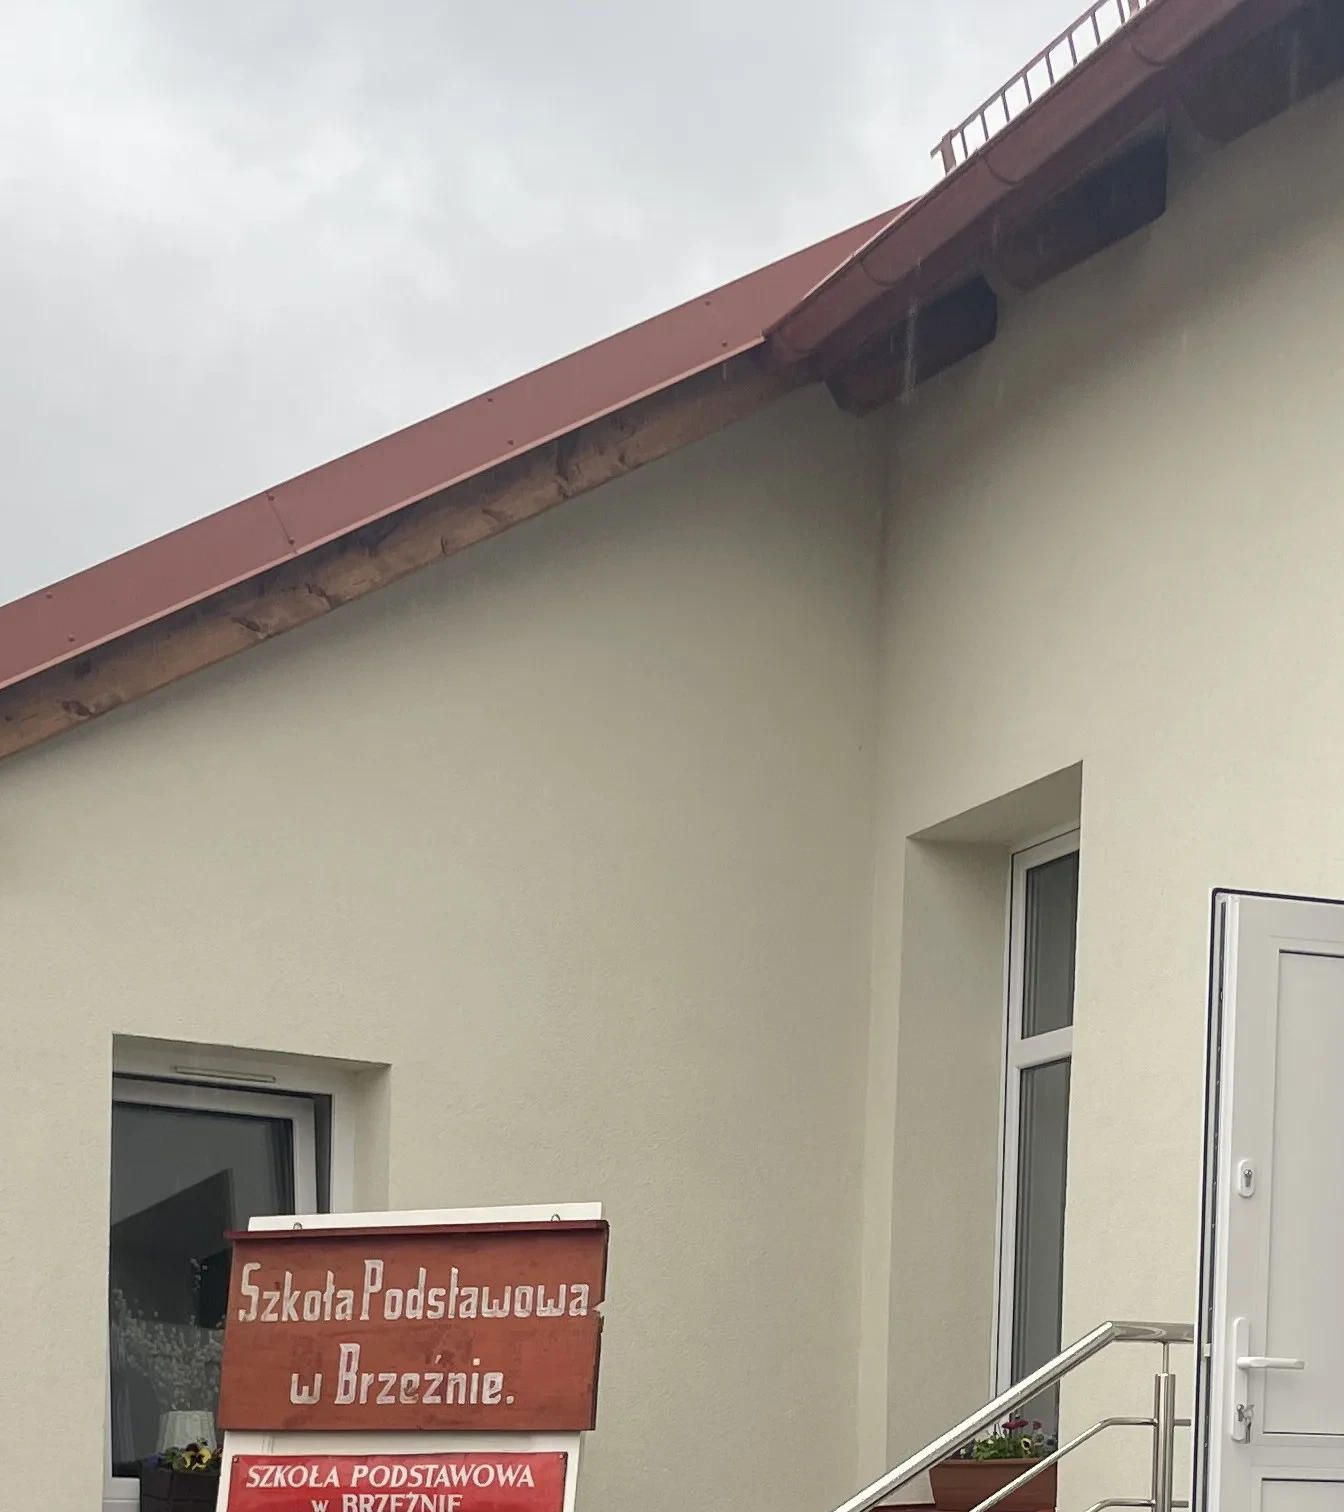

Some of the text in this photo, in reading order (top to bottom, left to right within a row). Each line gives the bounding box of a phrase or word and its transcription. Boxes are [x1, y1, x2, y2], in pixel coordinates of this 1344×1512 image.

[238, 1258, 591, 1322] Szkoła Podstawowa
[290, 1342, 516, 1406] w Brzeźnie.
[245, 1463, 536, 1489] SZKOŁA PODSTAWOWA
